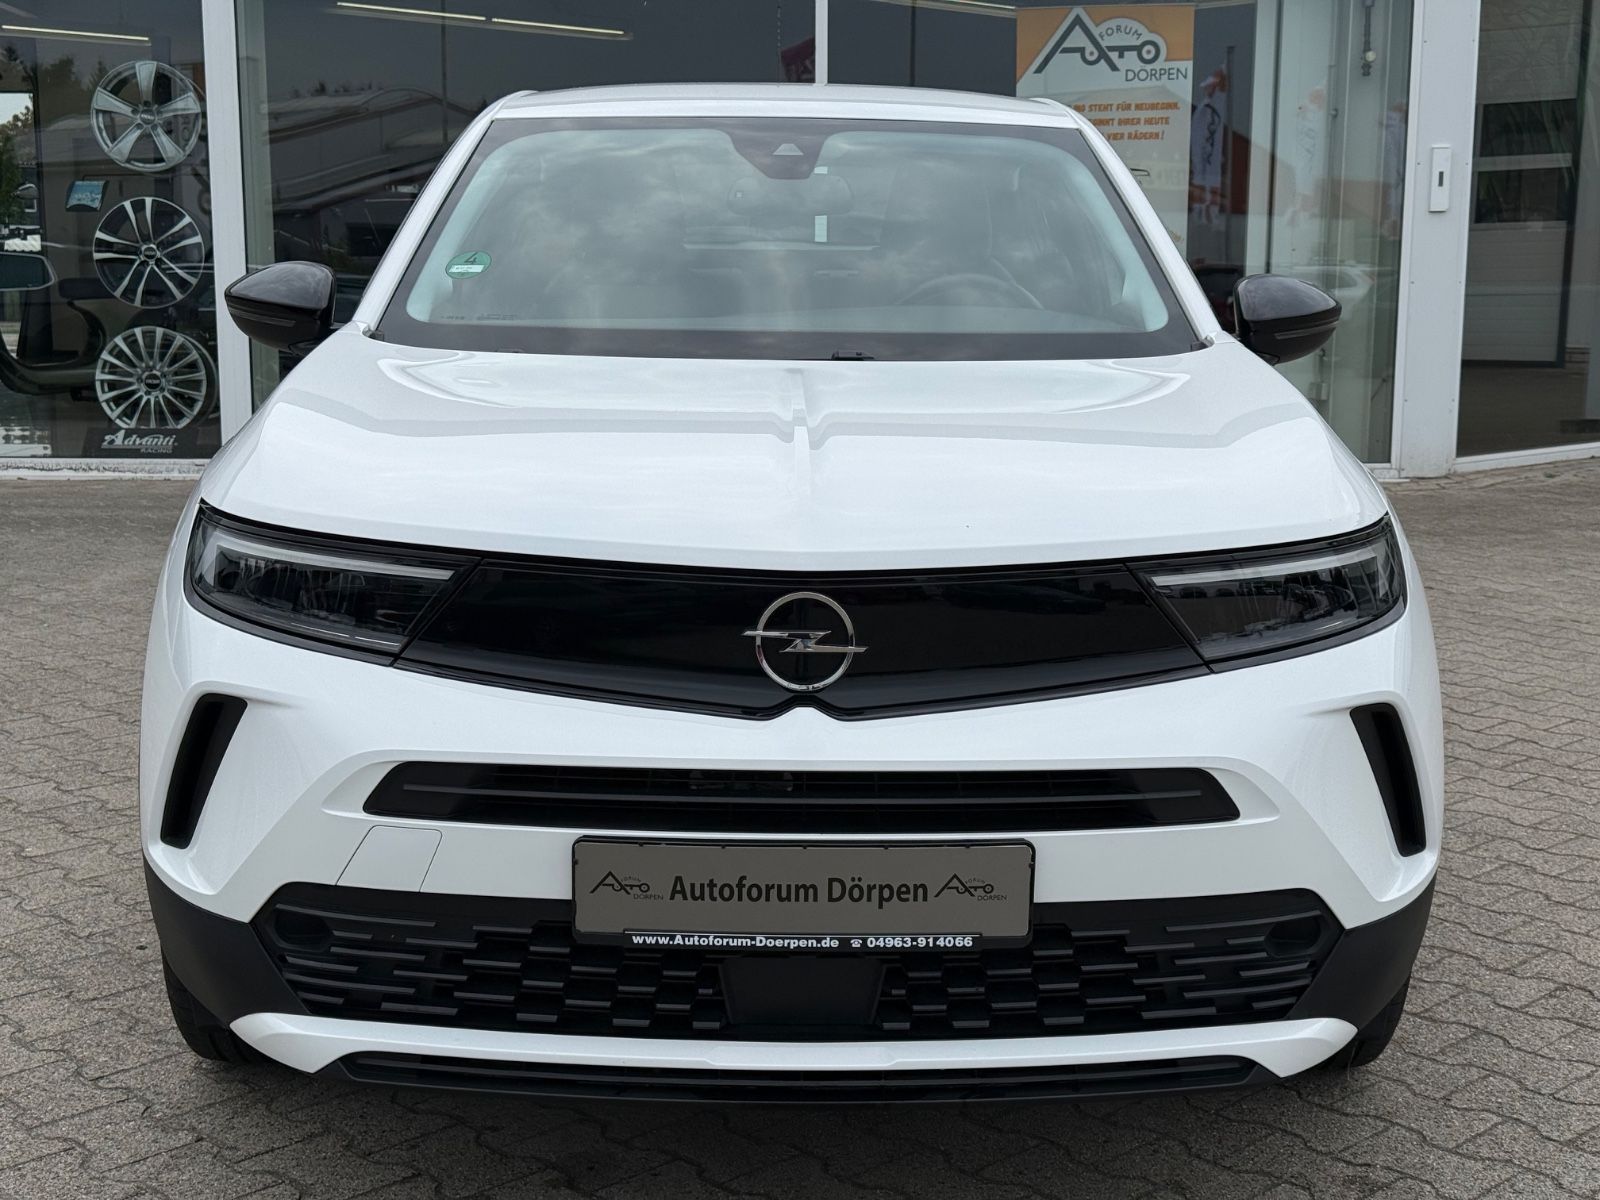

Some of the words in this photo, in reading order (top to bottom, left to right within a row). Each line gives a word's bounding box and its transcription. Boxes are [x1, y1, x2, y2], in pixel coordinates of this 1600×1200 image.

[1098, 25, 1143, 41] FORUM
[1088, 103, 1114, 113] STEHT
[1116, 101, 1132, 112] FÜR
[1143, 116, 1170, 126] HEUTE
[464, 252, 478, 264] 4
[669, 875, 819, 903] Autoforum
[827, 876, 928, 910] Dörpen
[632, 934, 840, 949] www.Autoforum-Doerpen.de
[866, 936, 974, 948] 04963-914066
